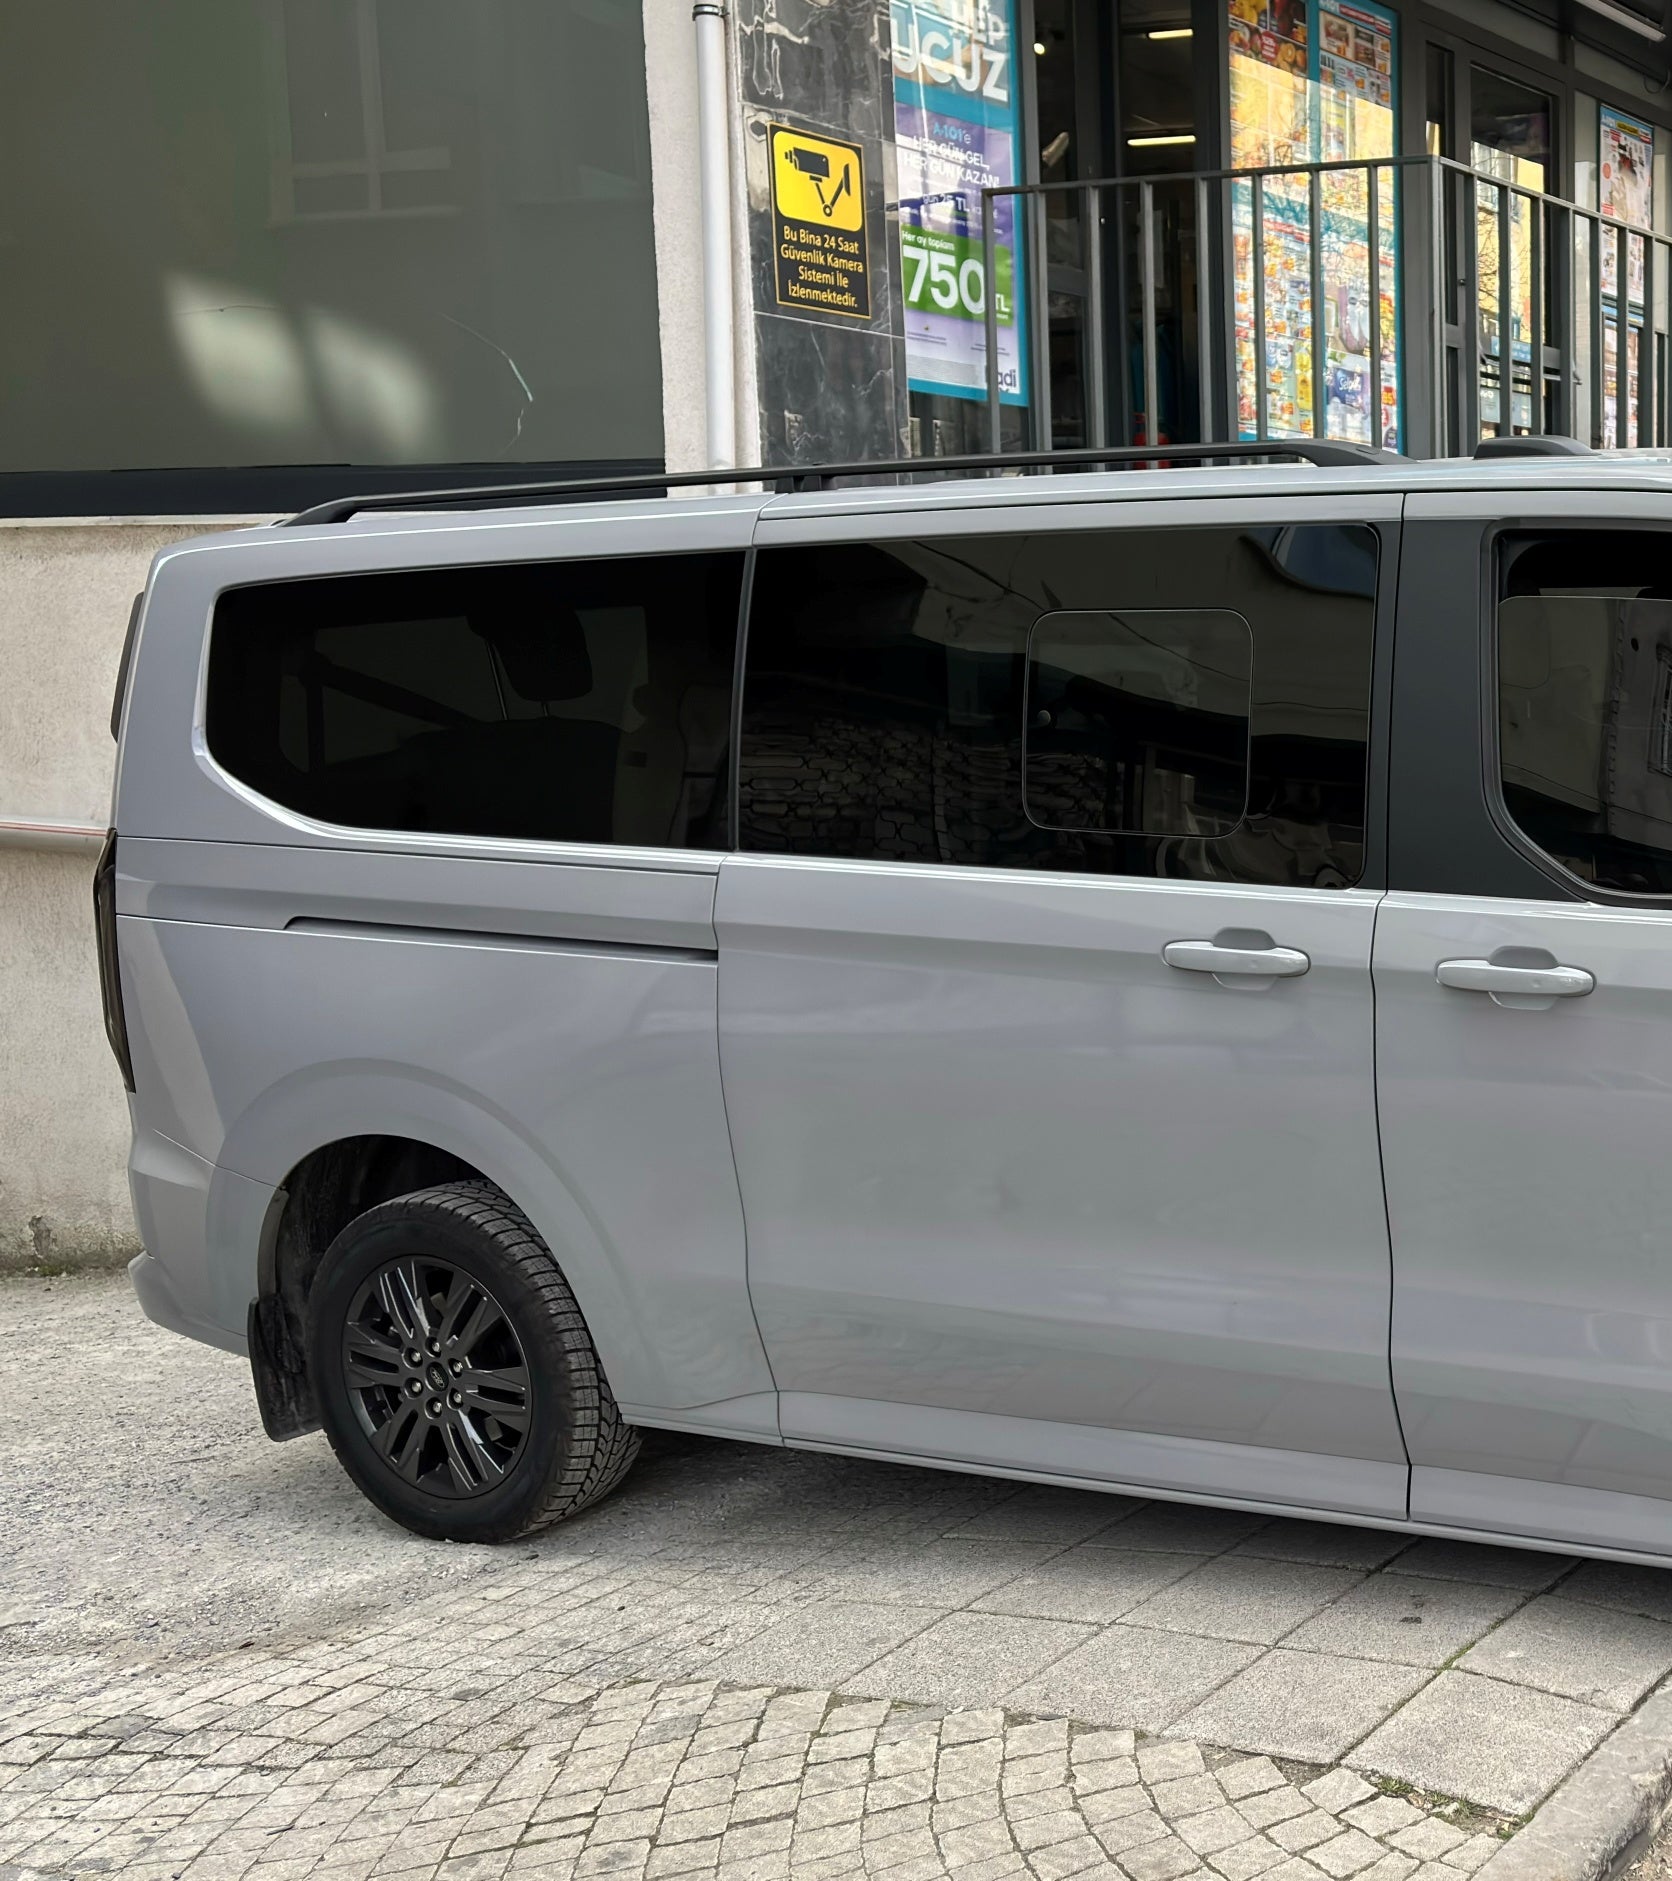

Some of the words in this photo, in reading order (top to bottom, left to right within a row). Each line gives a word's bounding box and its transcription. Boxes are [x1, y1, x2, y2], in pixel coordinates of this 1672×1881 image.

[965, 150, 991, 171] GEL,
[783, 225, 797, 241] Bu
[799, 228, 822, 247] Bina
[823, 233, 836, 249] 24
[837, 236, 859, 254] Saat
[780, 243, 825, 265] Güvenlik
[827, 252, 863, 273] Kamera
[798, 265, 835, 285] Sistemi
[903, 245, 985, 315] 750
[788, 279, 858, 308] İzlenmektedir.
